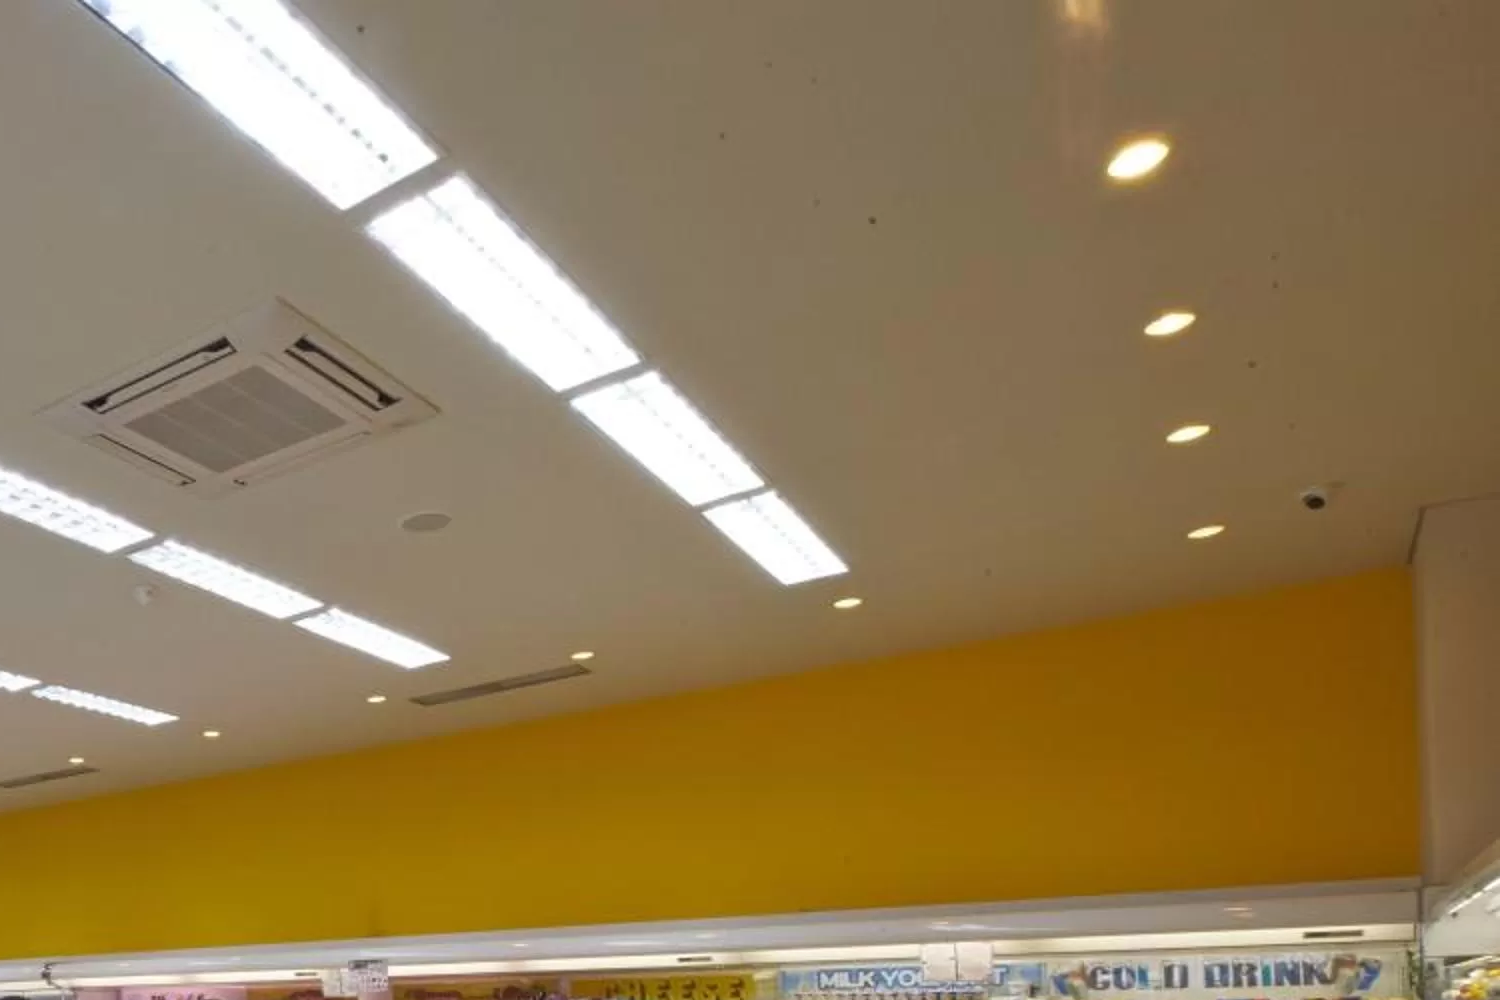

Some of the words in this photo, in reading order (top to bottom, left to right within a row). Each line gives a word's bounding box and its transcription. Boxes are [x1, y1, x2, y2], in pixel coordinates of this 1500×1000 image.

[819, 970, 875, 989] MILK
[1089, 959, 1189, 991] COLD
[1203, 955, 1329, 990] DRINK
